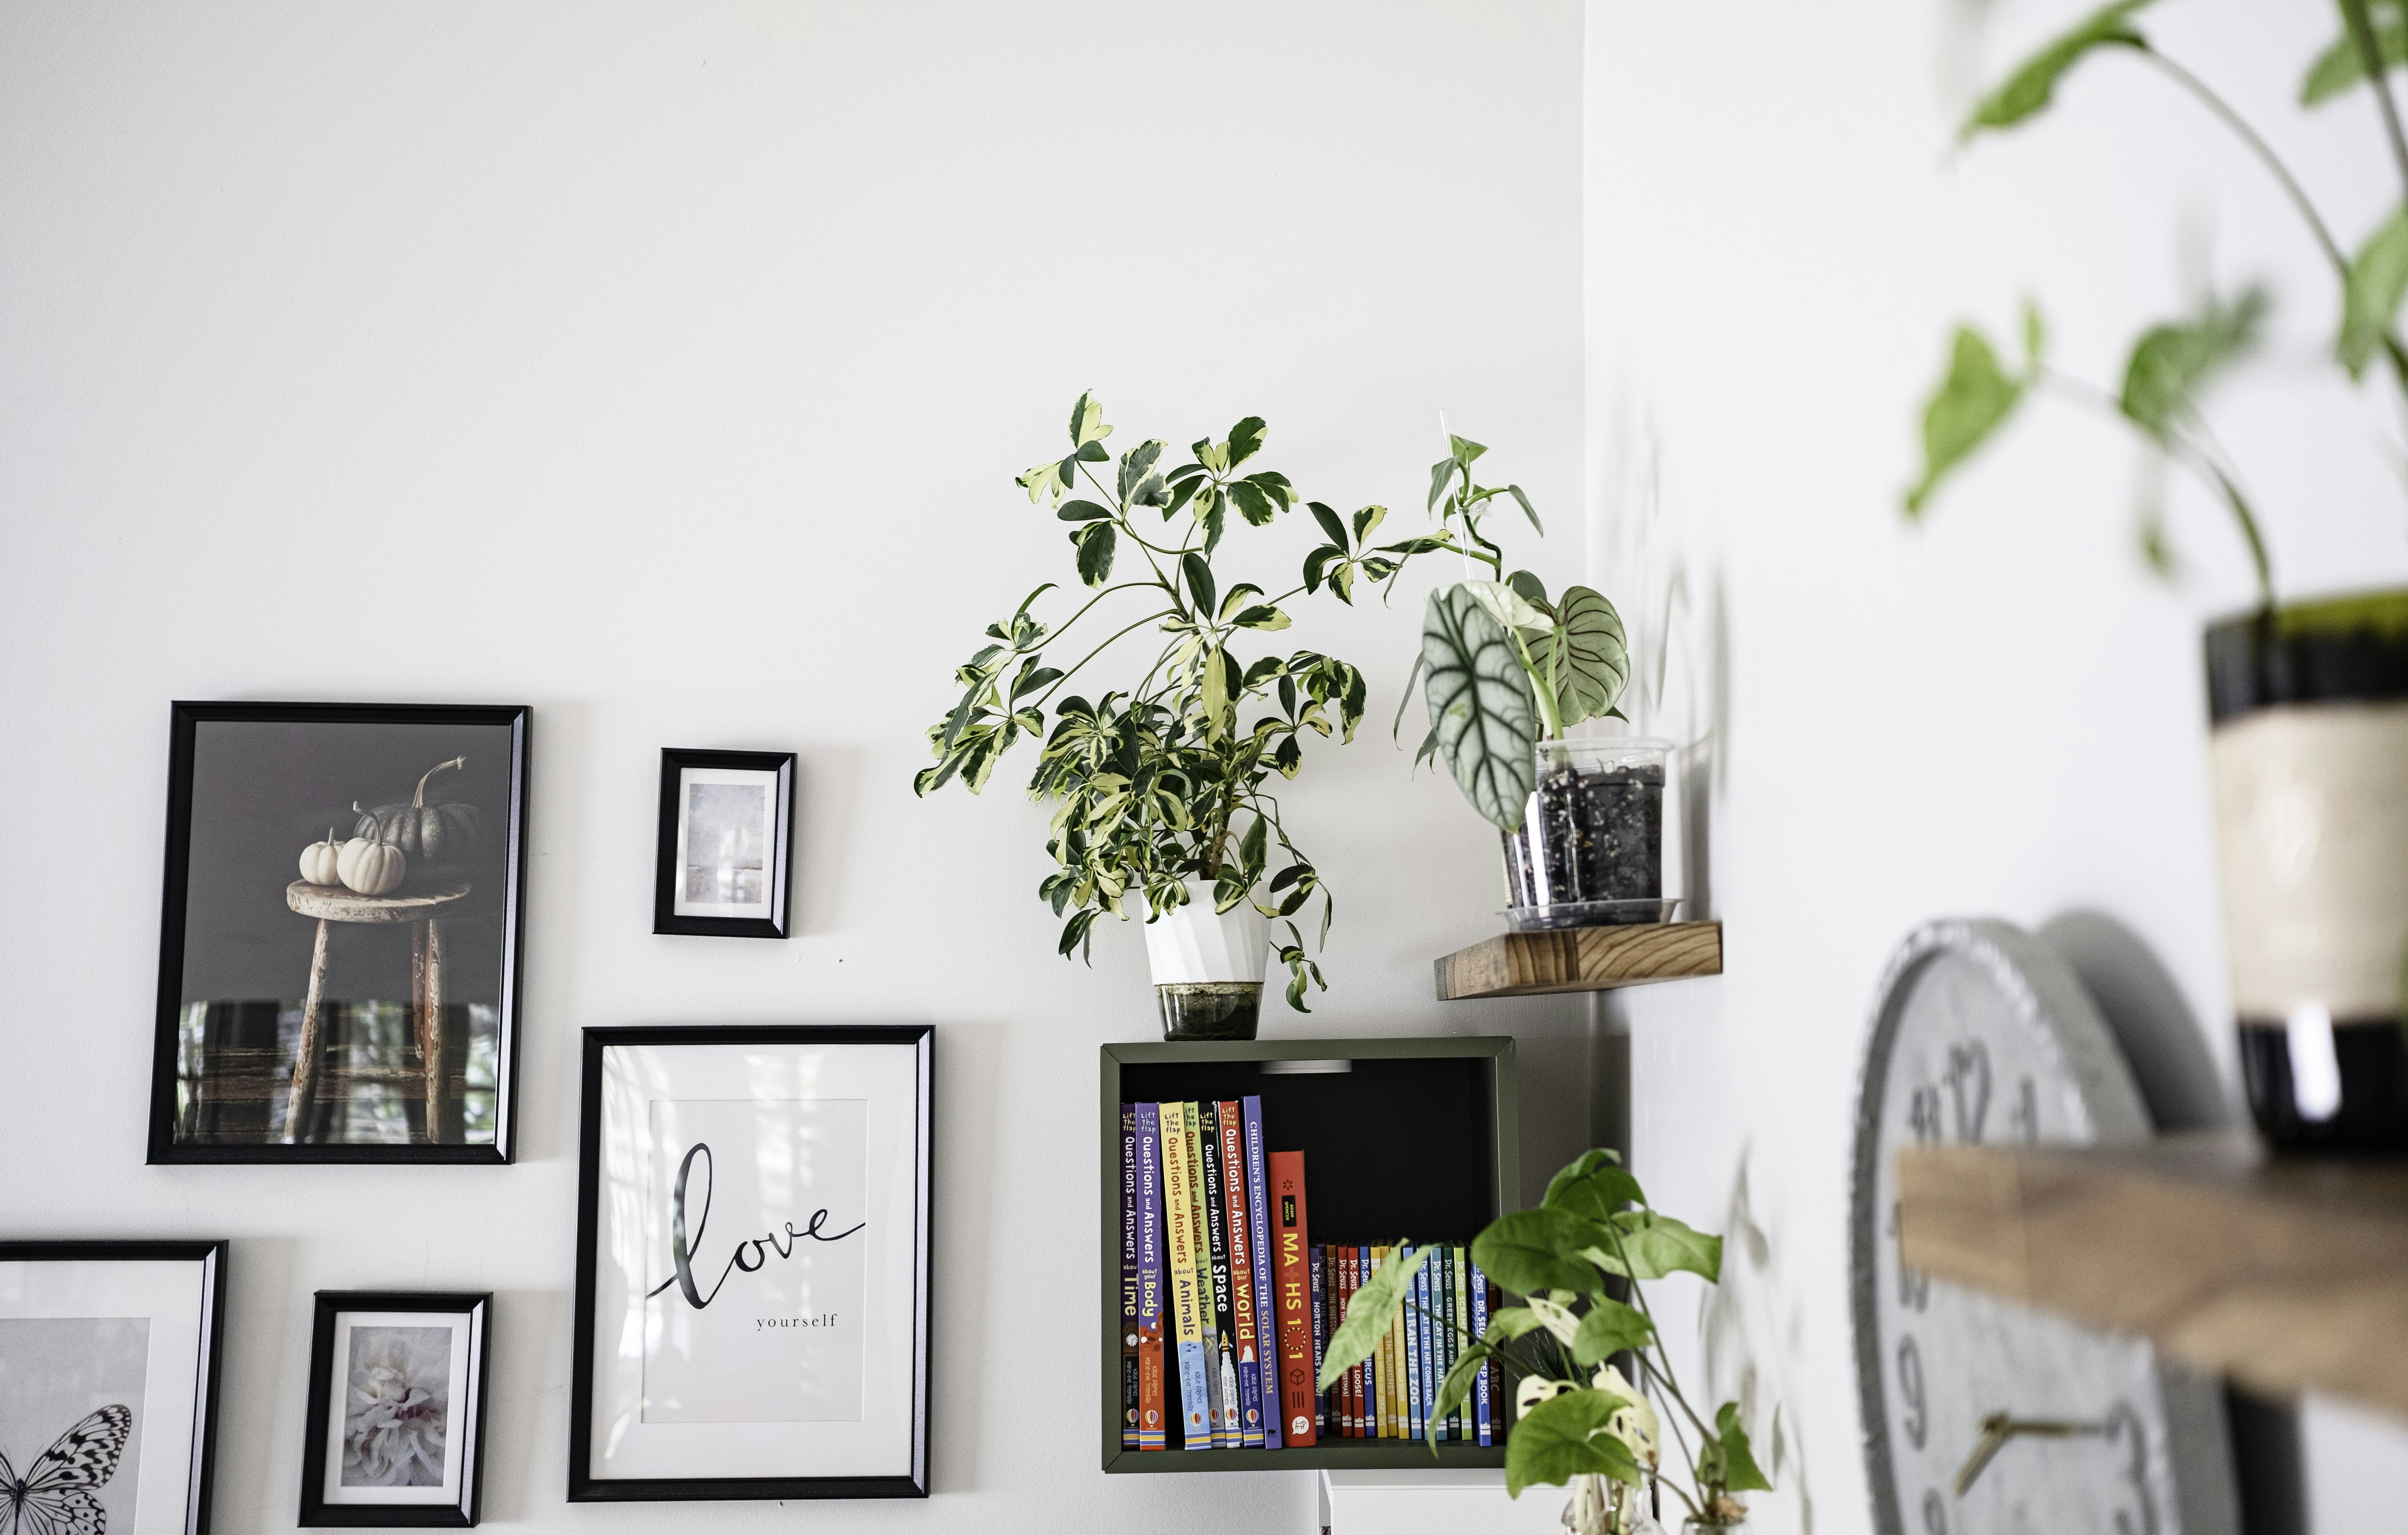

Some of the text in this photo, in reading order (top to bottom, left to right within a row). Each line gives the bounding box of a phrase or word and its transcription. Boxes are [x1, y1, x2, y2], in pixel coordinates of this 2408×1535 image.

[1141, 1126, 1156, 1134] flap
[1126, 1137, 1136, 1193] Questions
[1143, 1137, 1154, 1196] Questions
[1168, 1137, 1181, 1196] Questions
[1185, 1131, 1199, 1188] Questions
[1205, 1144, 1217, 1195] Questions
[1226, 1129, 1245, 1265] Questions and Answers
[646, 1142, 866, 1309] love
[1126, 1210, 1136, 1259] Answers
[1144, 1212, 1154, 1262] Answers
[1174, 1213, 1186, 1263] Answers
[1191, 1205, 1203, 1253] Answers
[1210, 1209, 1221, 1252] Answers
[1250, 1121, 1274, 1394] CHILDREN'S ENCYCLOPEDIA OF THE SOLAR SYSTEM
[1433, 1260, 1441, 1271] Dr.
[1124, 1274, 1139, 1316] Time
[1142, 1281, 1158, 1317] Body
[1197, 1267, 1210, 1324] Weather
[1213, 1264, 1227, 1312] Space
[1320, 1288, 1326, 1300] OH
[1433, 1273, 1441, 1292] Seuss
[1476, 1274, 1485, 1294] Seuss
[756, 1313, 838, 1332] yourself
[1179, 1279, 1196, 1336] Animals
[1236, 1283, 1255, 1340] World
[1386, 1340, 1392, 1350] IN
[1407, 1319, 1417, 1346] RAN
[1436, 1339, 1442, 1348] IN
[1355, 1370, 1363, 1397] LOOSE!
[1386, 1353, 1395, 1395] BUNCHES
[1409, 1349, 1418, 1374] THE
[1409, 1378, 1419, 1405] ZOO
[1897, 1332, 1927, 1453] 9
